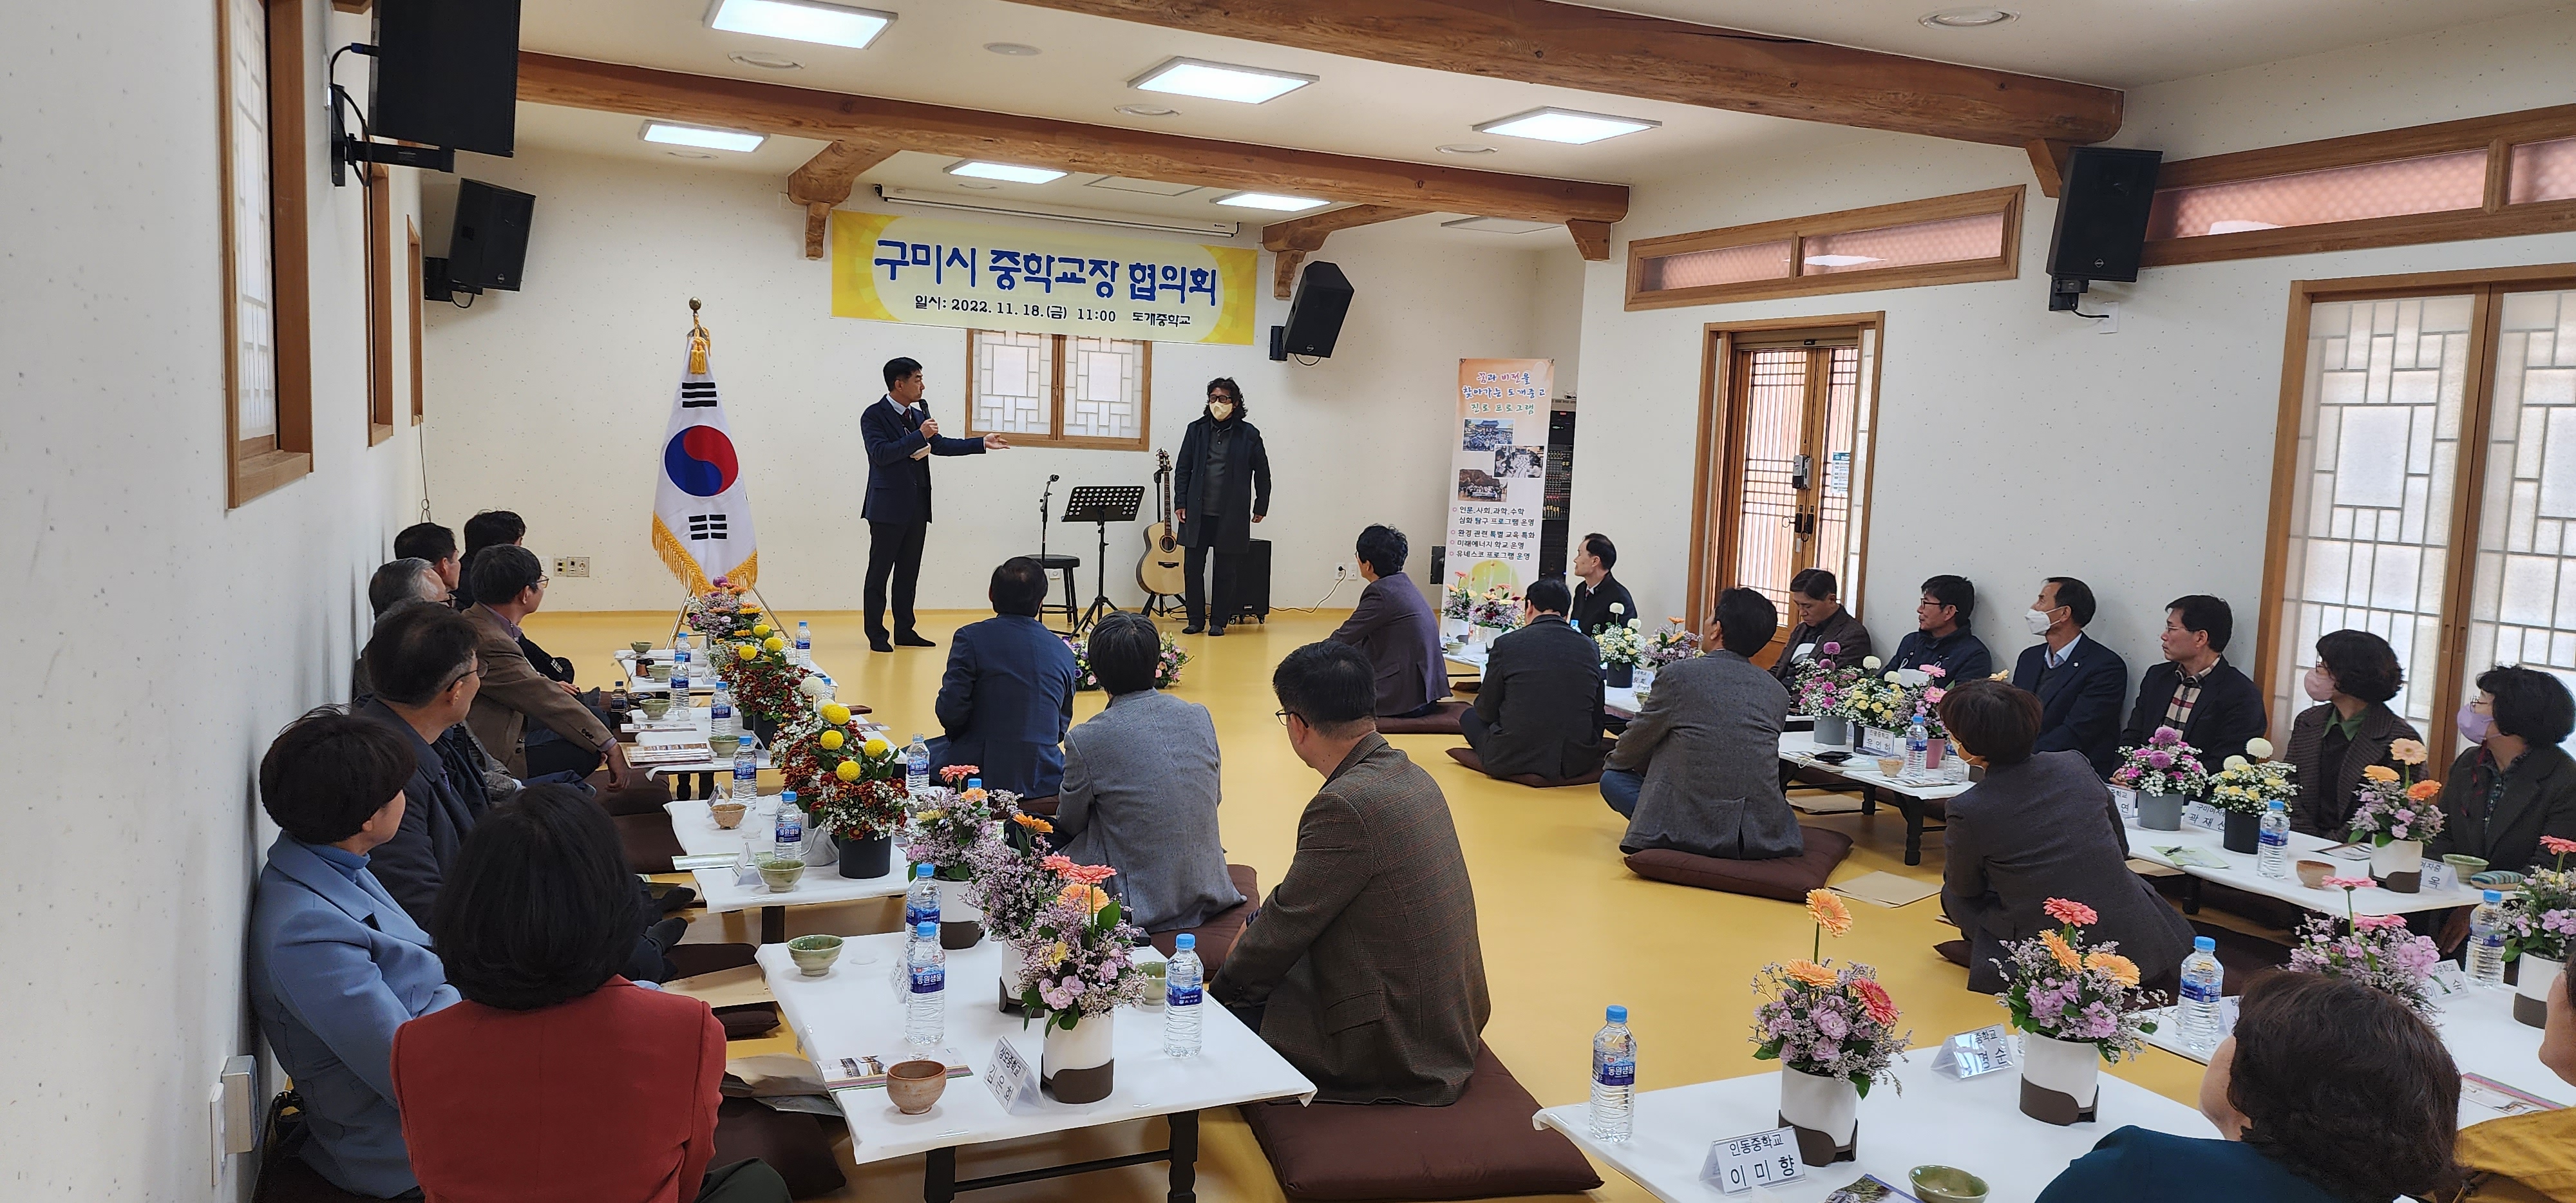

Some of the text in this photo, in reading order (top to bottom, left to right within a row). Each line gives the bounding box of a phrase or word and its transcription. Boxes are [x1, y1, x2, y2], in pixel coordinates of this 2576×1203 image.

[875, 239, 1216, 307] 구미시 중학교장 협의회
[915, 295, 947, 310] 일시:
[952, 299, 992, 314] 2022.
[998, 302, 1018, 316] 11.
[1077, 308, 1116, 321] 11:00
[1133, 312, 1191, 328] 도개중학교
[1477, 372, 1531, 385] 꿈과 비전을
[1463, 386, 1502, 399] 찾아가는
[1471, 403, 1534, 415] 진로 프로그램
[1490, 518, 1519, 526] 프로그램
[1521, 518, 1535, 527] 운영
[1457, 529, 1472, 538] 환경
[1490, 530, 1504, 538] 특별
[1506, 531, 1520, 539] 교육
[1521, 531, 1535, 540] 특화
[1494, 540, 1508, 549] 학교
[1510, 542, 1524, 550] 운영
[1486, 551, 1515, 560] 프로그램
[1517, 552, 1530, 561] 운영
[999, 1047, 1022, 1078] 상모중학교
[1729, 1133, 1785, 1157] 인동중학교
